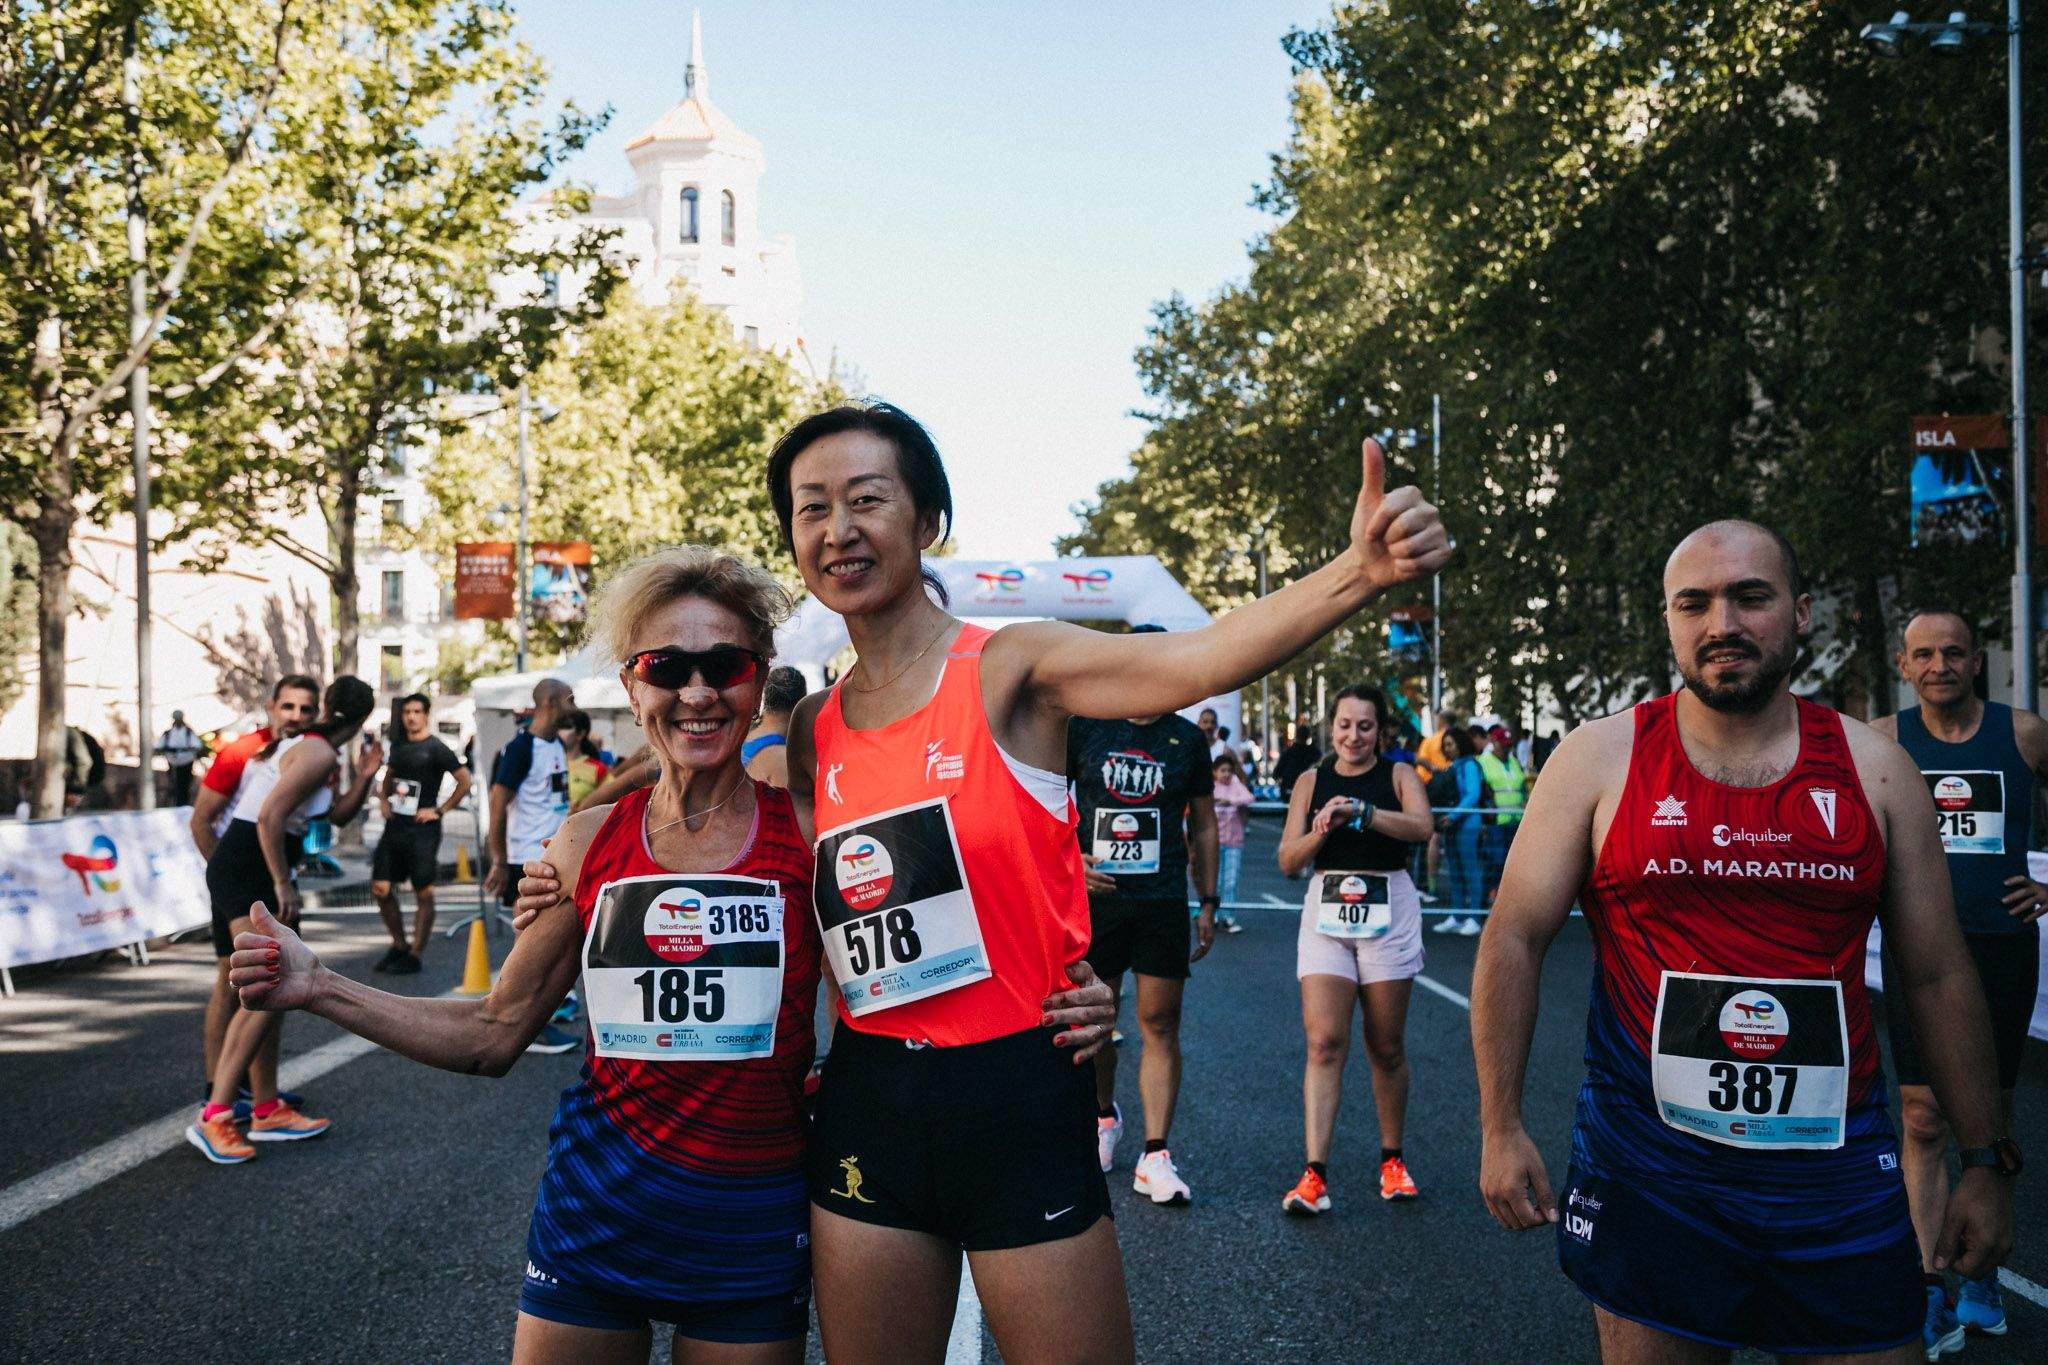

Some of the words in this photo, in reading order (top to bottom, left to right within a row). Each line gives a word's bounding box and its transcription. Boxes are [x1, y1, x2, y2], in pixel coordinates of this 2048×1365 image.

[1915, 430, 1957, 446] ISLA
[1651, 815, 1688, 826] luanvi
[1936, 813, 1977, 836] 215
[1731, 828, 1793, 846] alquiber
[1110, 842, 1143, 861] 223
[1642, 858, 1694, 876] A.D.
[1703, 859, 1855, 881] MARATHON
[851, 895, 859, 904] DE
[861, 888, 885, 901] MADRID
[855, 883, 875, 893] MILLA
[708, 904, 770, 935] 3185
[1339, 905, 1369, 923] 407
[658, 923, 702, 931] TotalEnergies
[843, 908, 922, 976] 578
[634, 968, 725, 1023] 185
[1734, 1022, 1775, 1030] TotalEnergies
[614, 1033, 647, 1044] MADRID
[1708, 1062, 1798, 1115] 387
